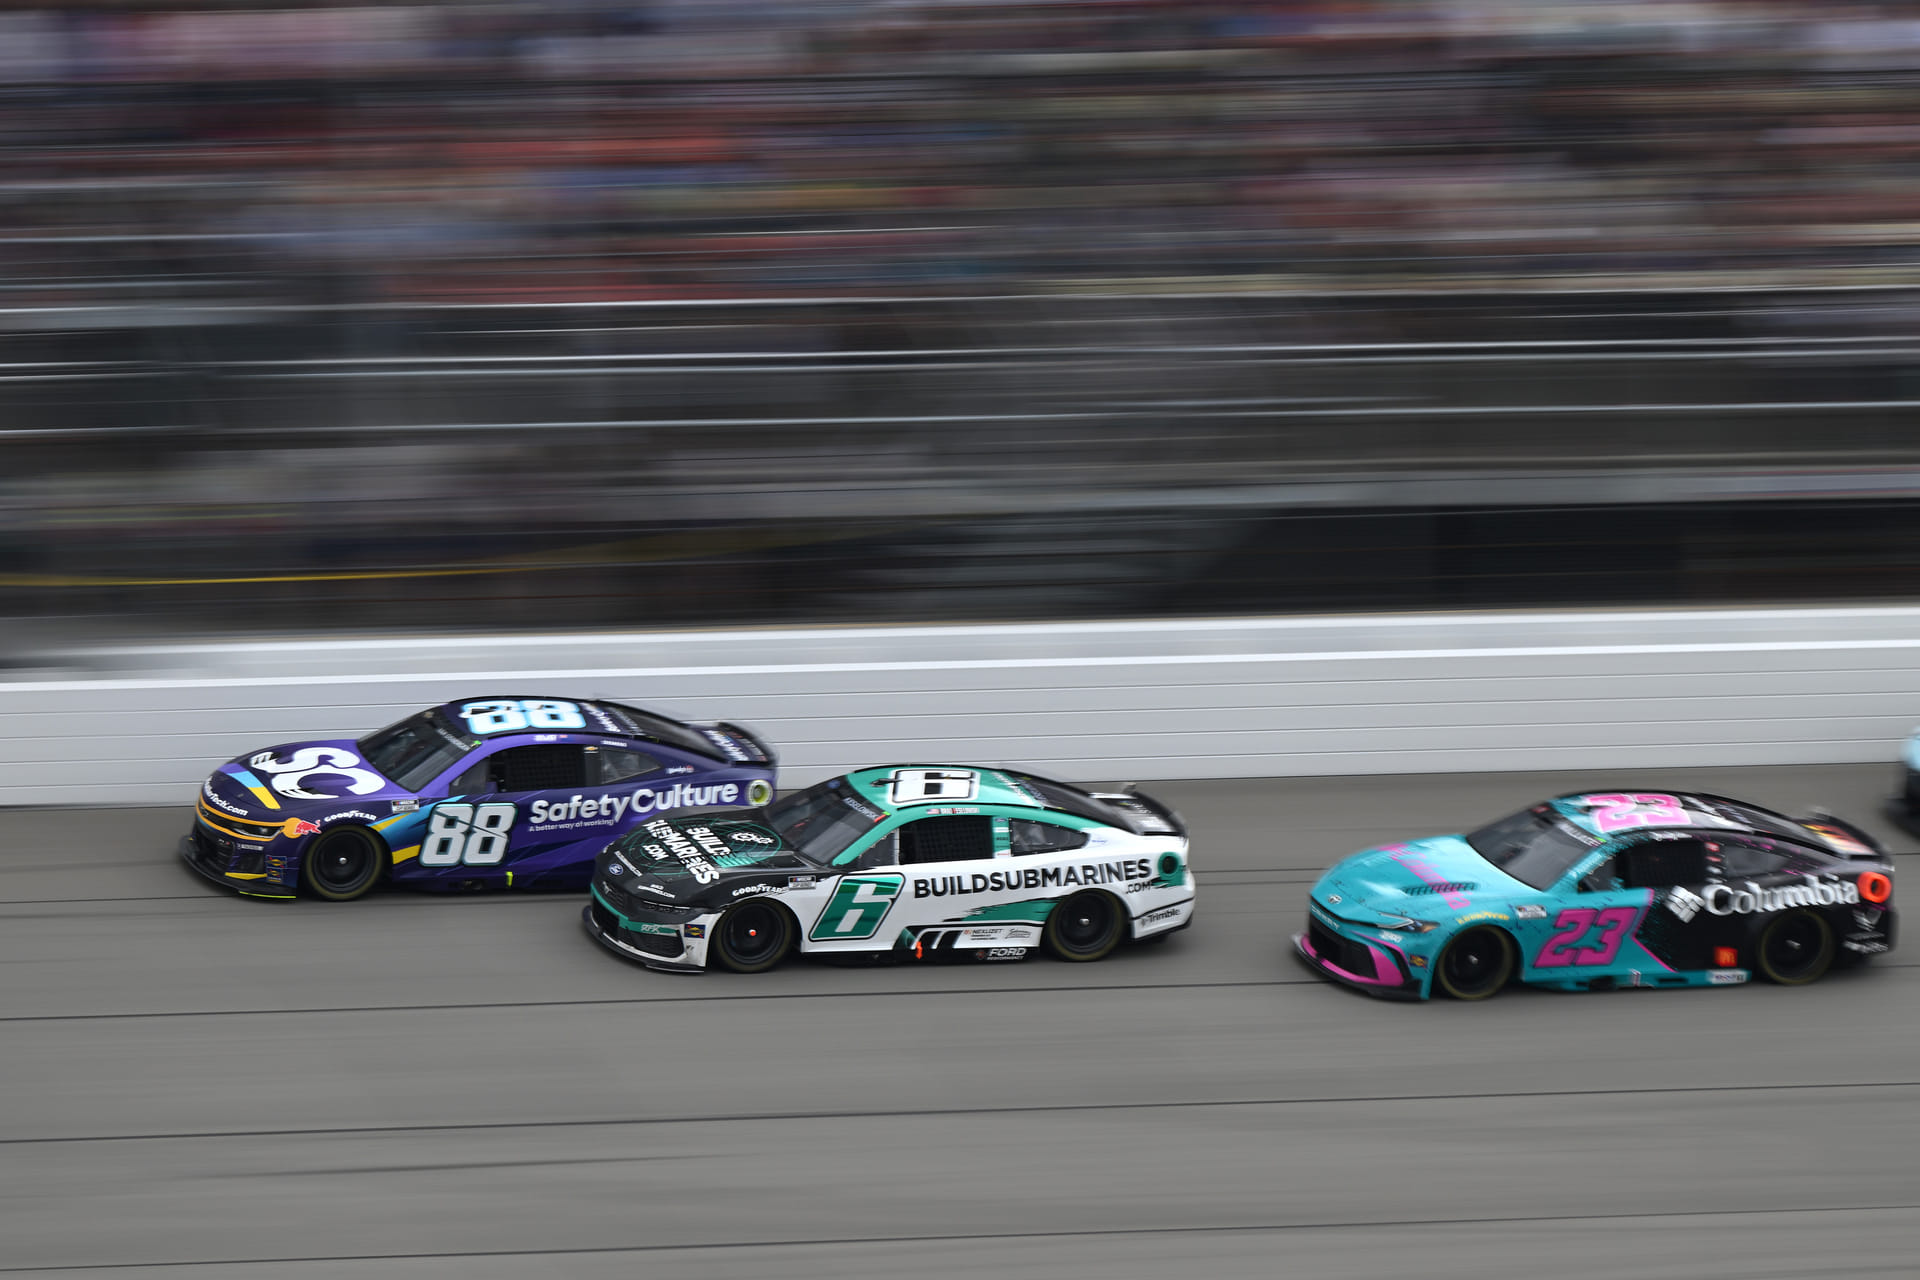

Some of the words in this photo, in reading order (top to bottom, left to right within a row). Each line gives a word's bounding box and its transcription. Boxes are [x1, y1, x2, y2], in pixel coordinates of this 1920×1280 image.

[461, 700, 587, 735] 88
[324, 810, 377, 822] GOODYEAR
[529, 783, 739, 824] SafetyCulture
[1587, 794, 1692, 833] 23
[418, 802, 518, 867] 88
[536, 823, 559, 832] better
[559, 823, 574, 831] way
[575, 821, 584, 829] of
[584, 818, 614, 827] working
[732, 883, 782, 896] GOODYEAR
[913, 858, 1152, 898] BUILDSUBMARINES
[1125, 881, 1151, 894] .COM
[1701, 873, 1860, 916] Columbia
[809, 872, 905, 942] 6
[1147, 908, 1180, 922] Trimble
[989, 947, 1027, 957] FORD
[1534, 907, 1638, 968] 23
